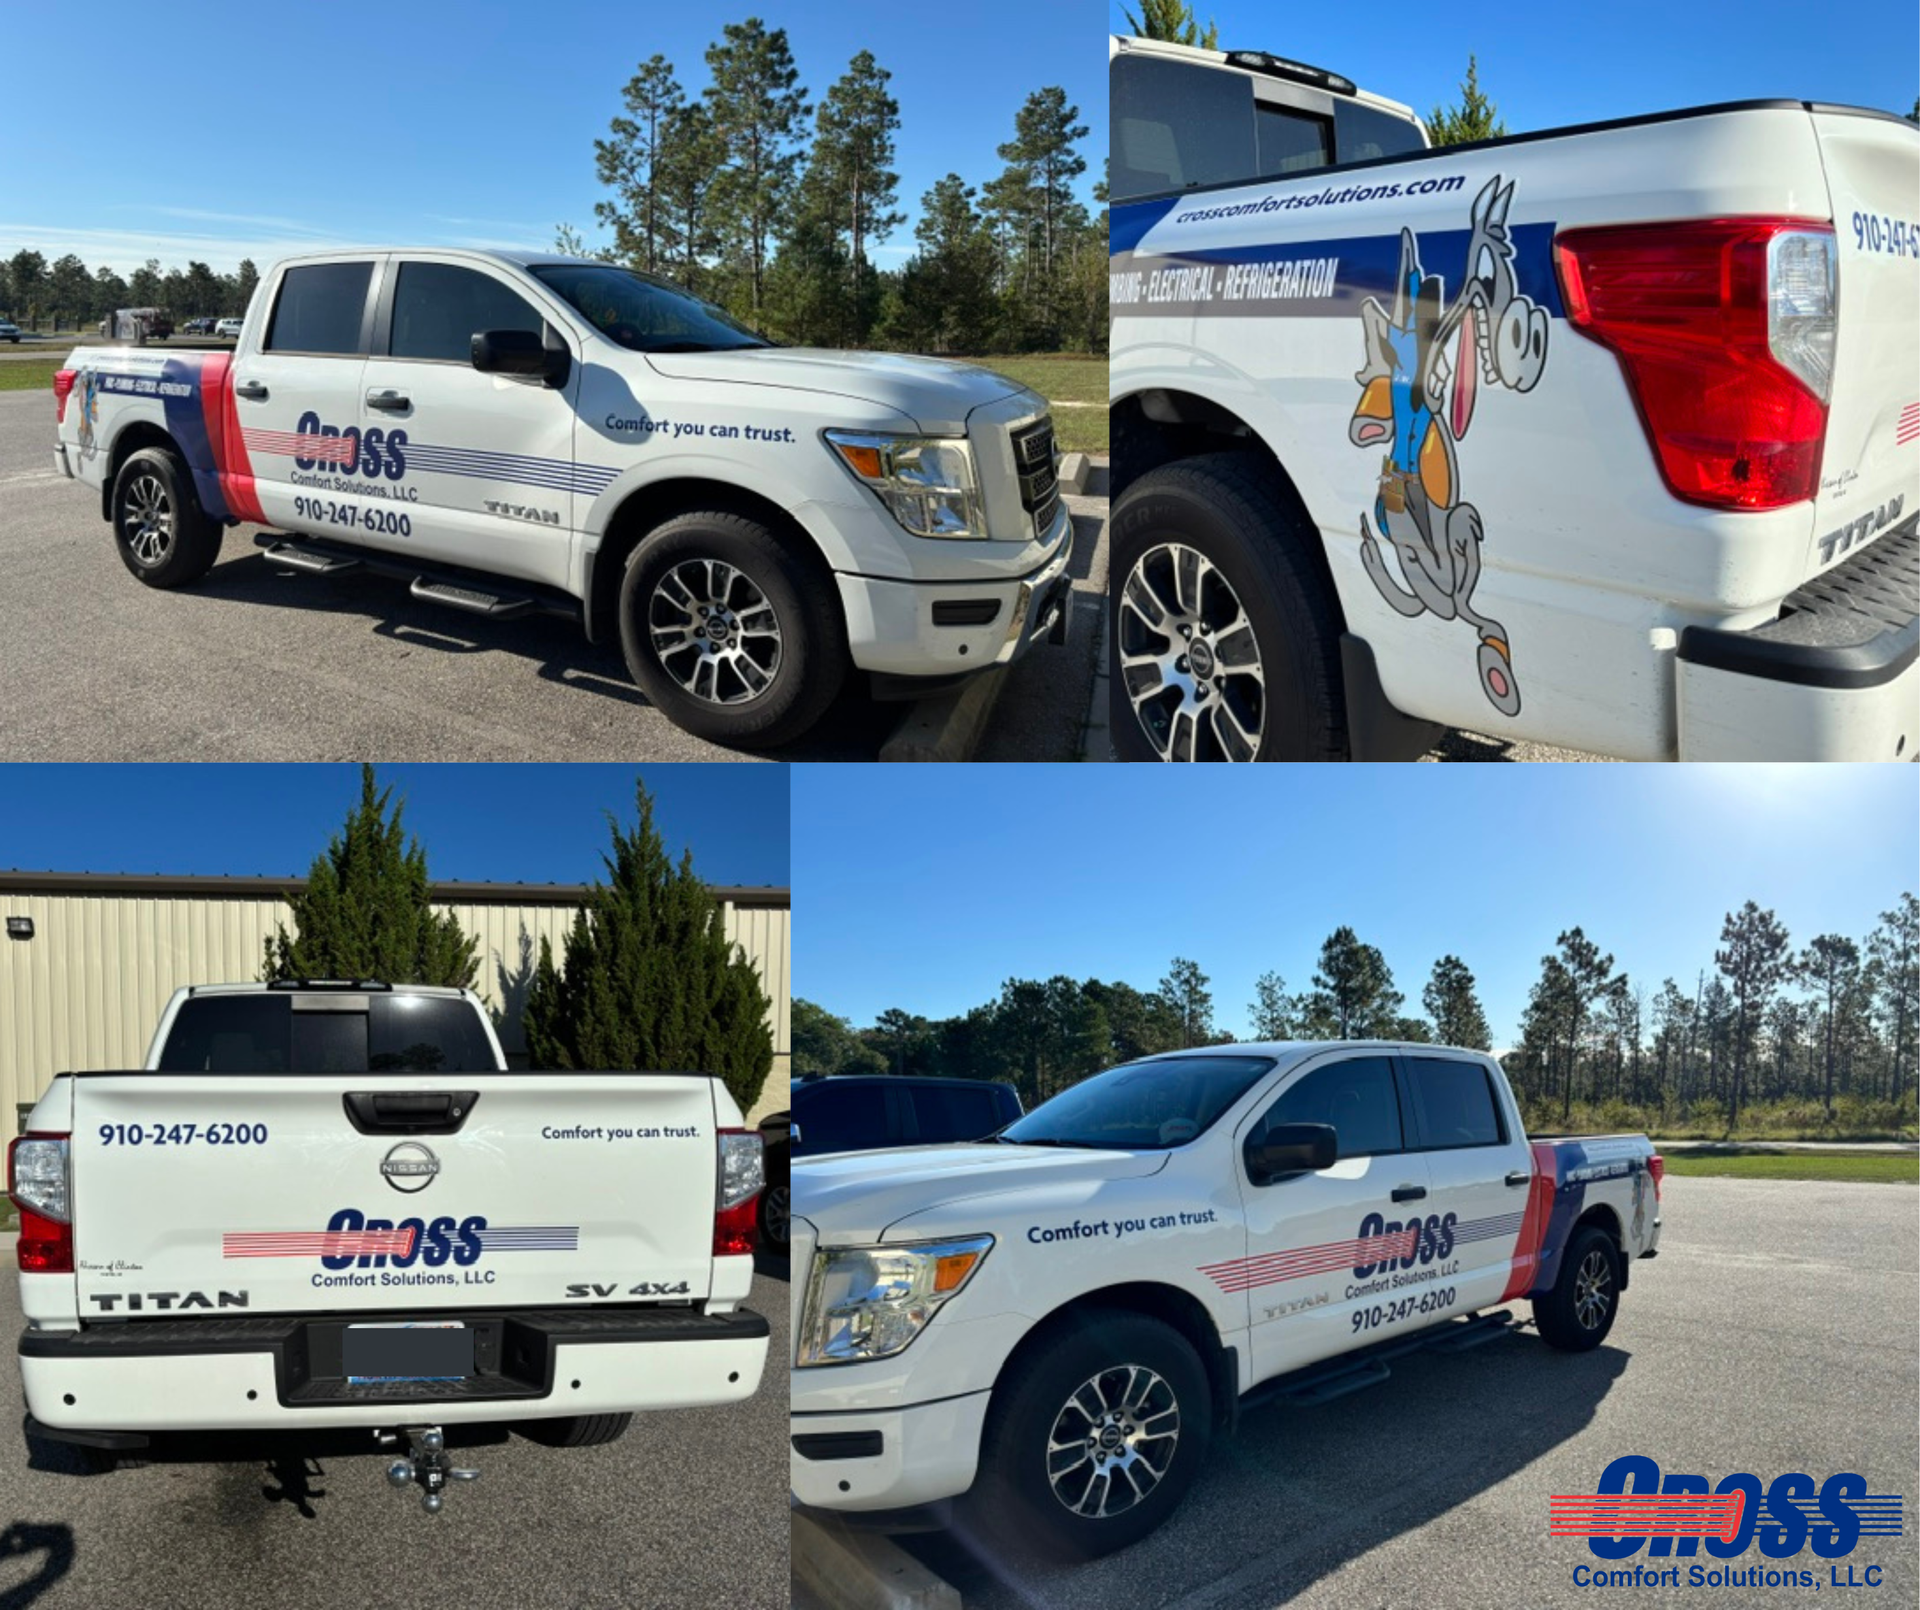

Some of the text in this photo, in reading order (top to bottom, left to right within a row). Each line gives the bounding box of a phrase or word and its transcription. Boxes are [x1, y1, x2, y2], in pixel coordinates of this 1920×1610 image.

[1176, 174, 1466, 224] crosscomfortsolutions.com
[1147, 266, 1215, 302] ELECTRICAL
[1223, 258, 1340, 299] REFRIGERATION
[605, 413, 796, 444] Comfort you can trust.
[290, 471, 419, 502] Comfort Solutions, LLC
[294, 496, 412, 537] 910-247-6200
[483, 500, 561, 525] TITAN
[1818, 493, 1905, 566] TITAN
[99, 1124, 268, 1145] 910-247-6200
[541, 1126, 701, 1142] Comfort you can trust.
[382, 1164, 438, 1173] NISSAN
[1027, 1209, 1218, 1244] Comfort you can trust.
[311, 1269, 496, 1288] Comfort Solutions, LLC
[565, 1284, 618, 1299] SV
[1345, 1260, 1460, 1300] Comfort Solutions, LLC
[90, 1290, 249, 1311] TITAN
[1263, 1292, 1330, 1318] TITAN
[1352, 1287, 1457, 1334] 910-247-6200
